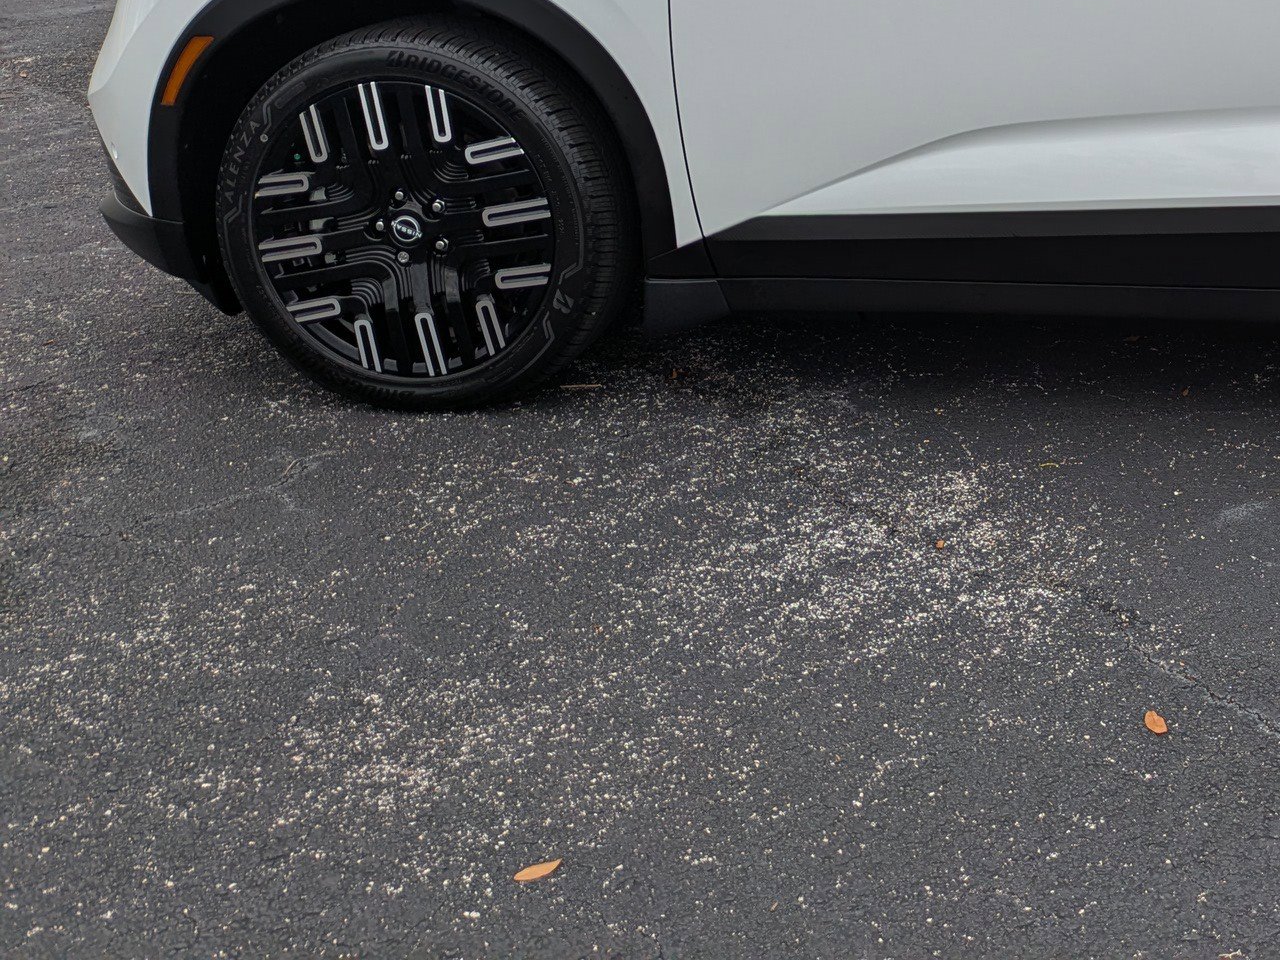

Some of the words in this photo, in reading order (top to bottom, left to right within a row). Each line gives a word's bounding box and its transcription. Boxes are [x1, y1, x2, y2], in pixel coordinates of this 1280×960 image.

[386, 49, 525, 122] BRIDGESTONE
[224, 119, 262, 203] ALENZA
[391, 220, 423, 239] NISSAN
